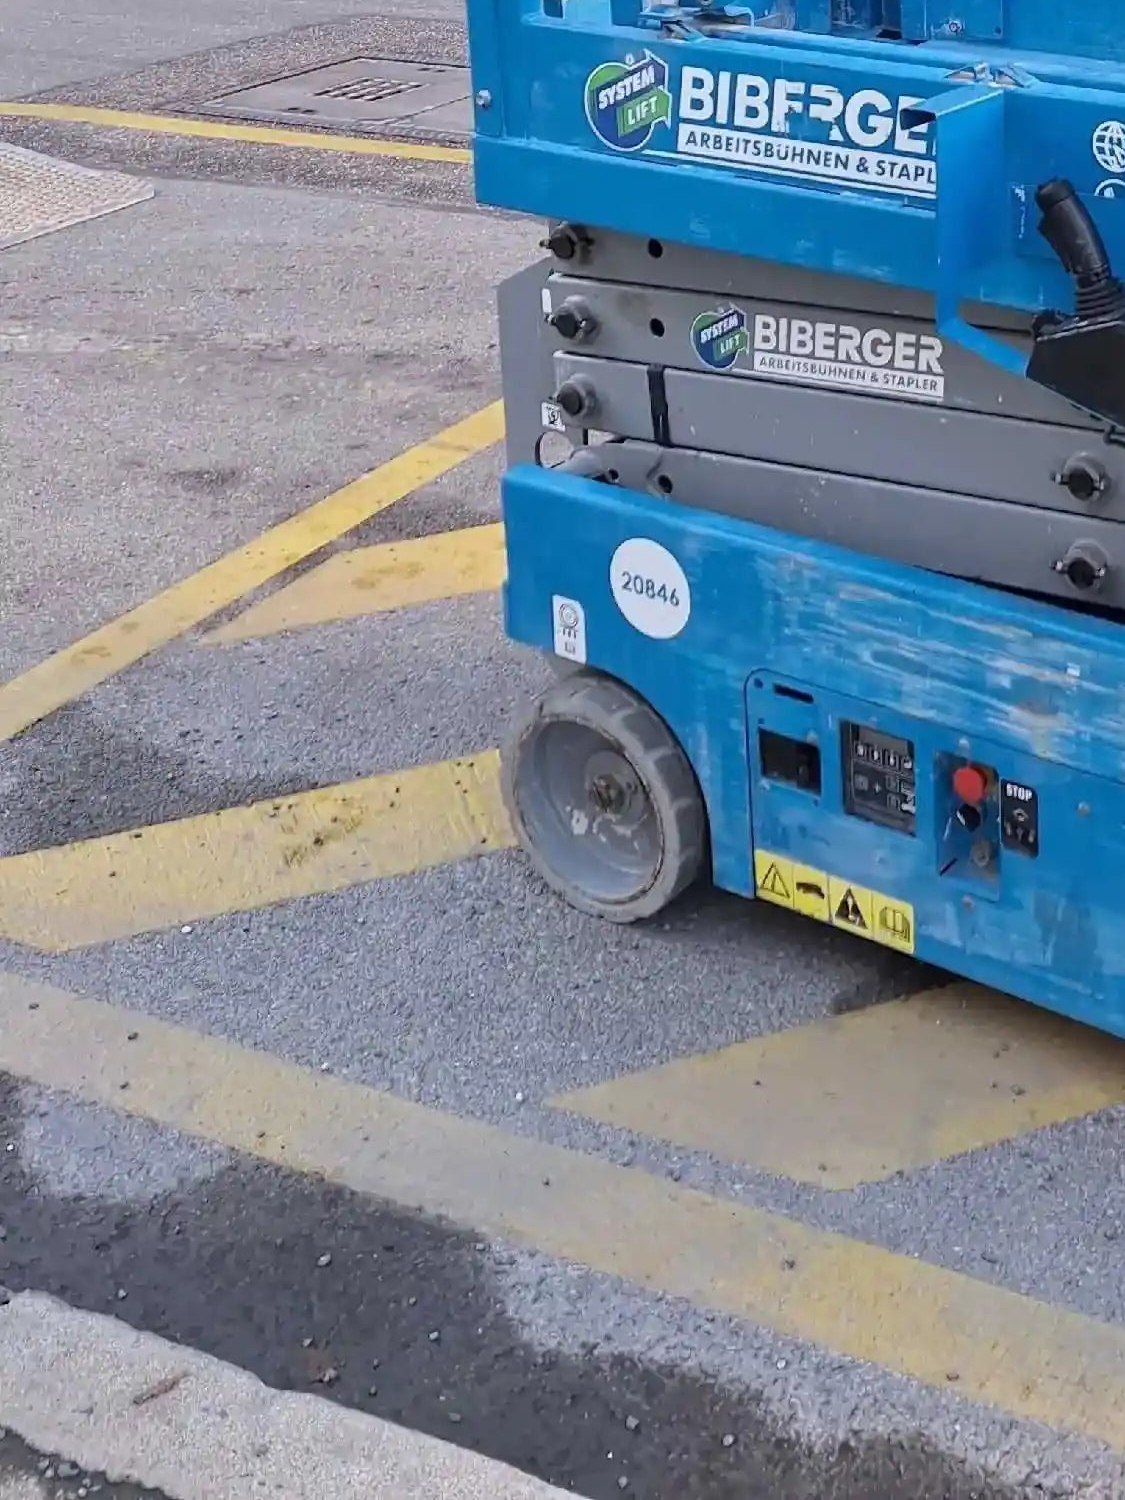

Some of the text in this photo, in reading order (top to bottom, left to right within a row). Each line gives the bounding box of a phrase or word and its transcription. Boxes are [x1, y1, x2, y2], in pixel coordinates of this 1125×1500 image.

[598, 64, 655, 110] SYSTEM
[627, 95, 658, 126] LIFT
[679, 65, 936, 156] BIBERGE
[684, 130, 850, 172] ARBEITSBÜHNEN
[856, 156, 870, 174] &
[700, 312, 740, 344] SYSTEM
[720, 333, 741, 355] LIFT
[753, 314, 943, 374] BIBERGER
[883, 373, 938, 392] STAPLER
[621, 570, 680, 607] 20846
[1006, 783, 1033, 801] STOP
